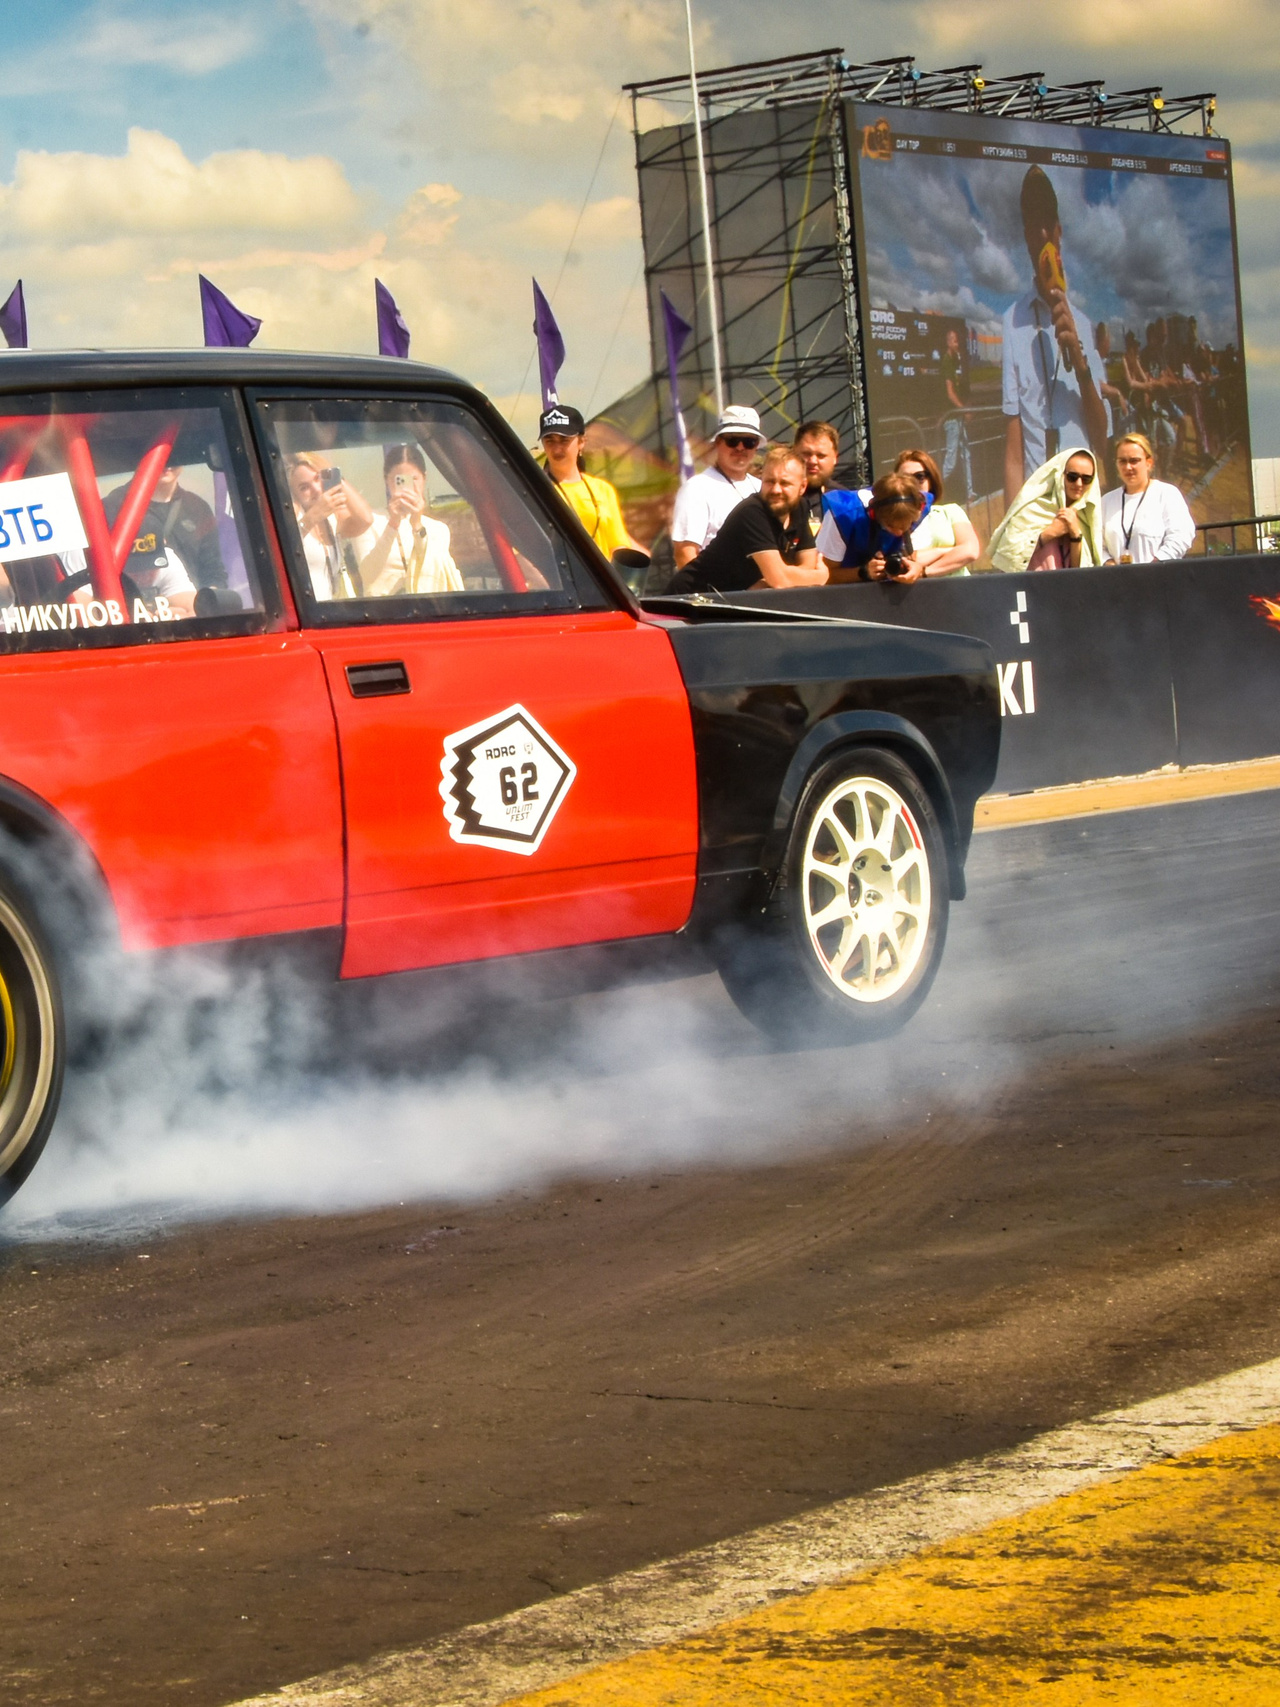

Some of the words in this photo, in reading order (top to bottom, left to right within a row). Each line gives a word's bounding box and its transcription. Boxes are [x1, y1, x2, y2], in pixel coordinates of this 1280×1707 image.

[896, 139, 907, 149] DAY
[908, 140, 920, 150] TOP
[882, 350, 896, 360] ВТБ
[1, 599, 124, 634] НИКУЛОВ
[133, 596, 180, 624] А.В.
[485, 745, 516, 760] RDRC
[499, 762, 539, 806] 62
[510, 812, 530, 822] FEST
